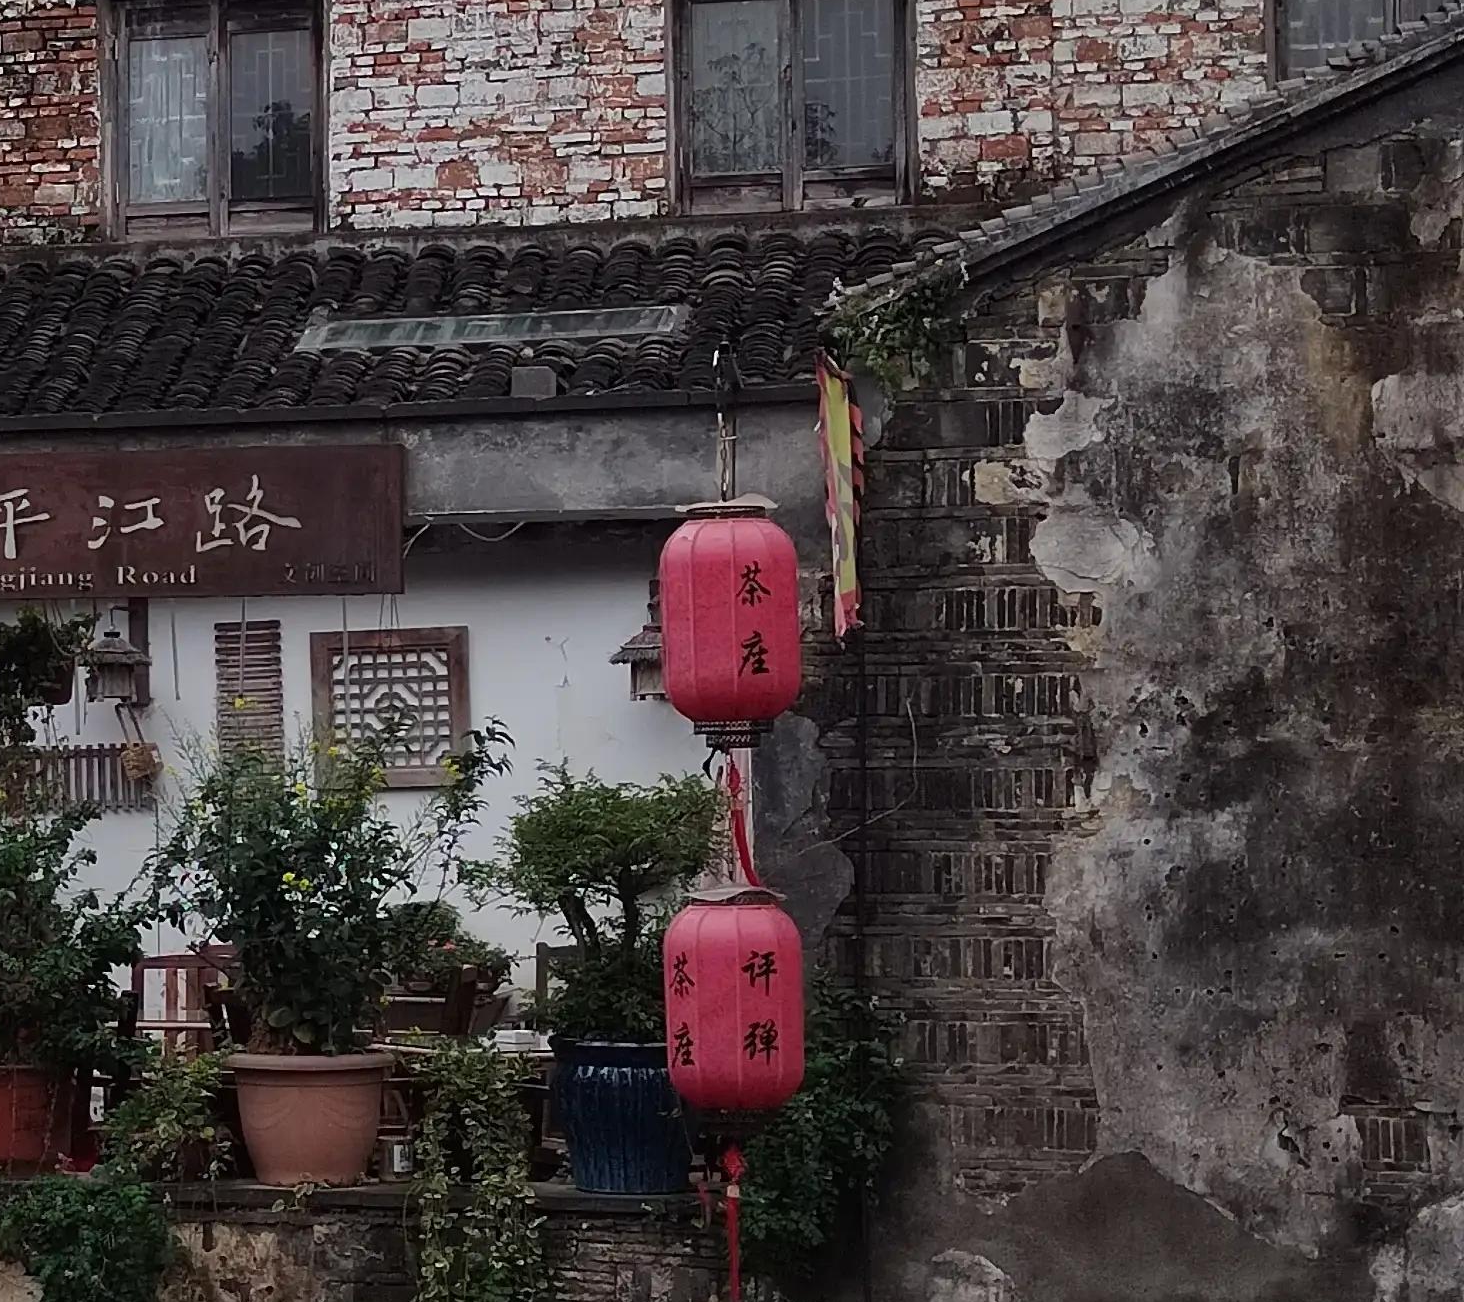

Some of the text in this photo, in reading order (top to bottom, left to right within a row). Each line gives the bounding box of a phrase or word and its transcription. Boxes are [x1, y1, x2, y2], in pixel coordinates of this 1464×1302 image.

[116, 564, 197, 586] Road
[736, 560, 771, 678] 茶座
[669, 951, 695, 1069] 茶座
